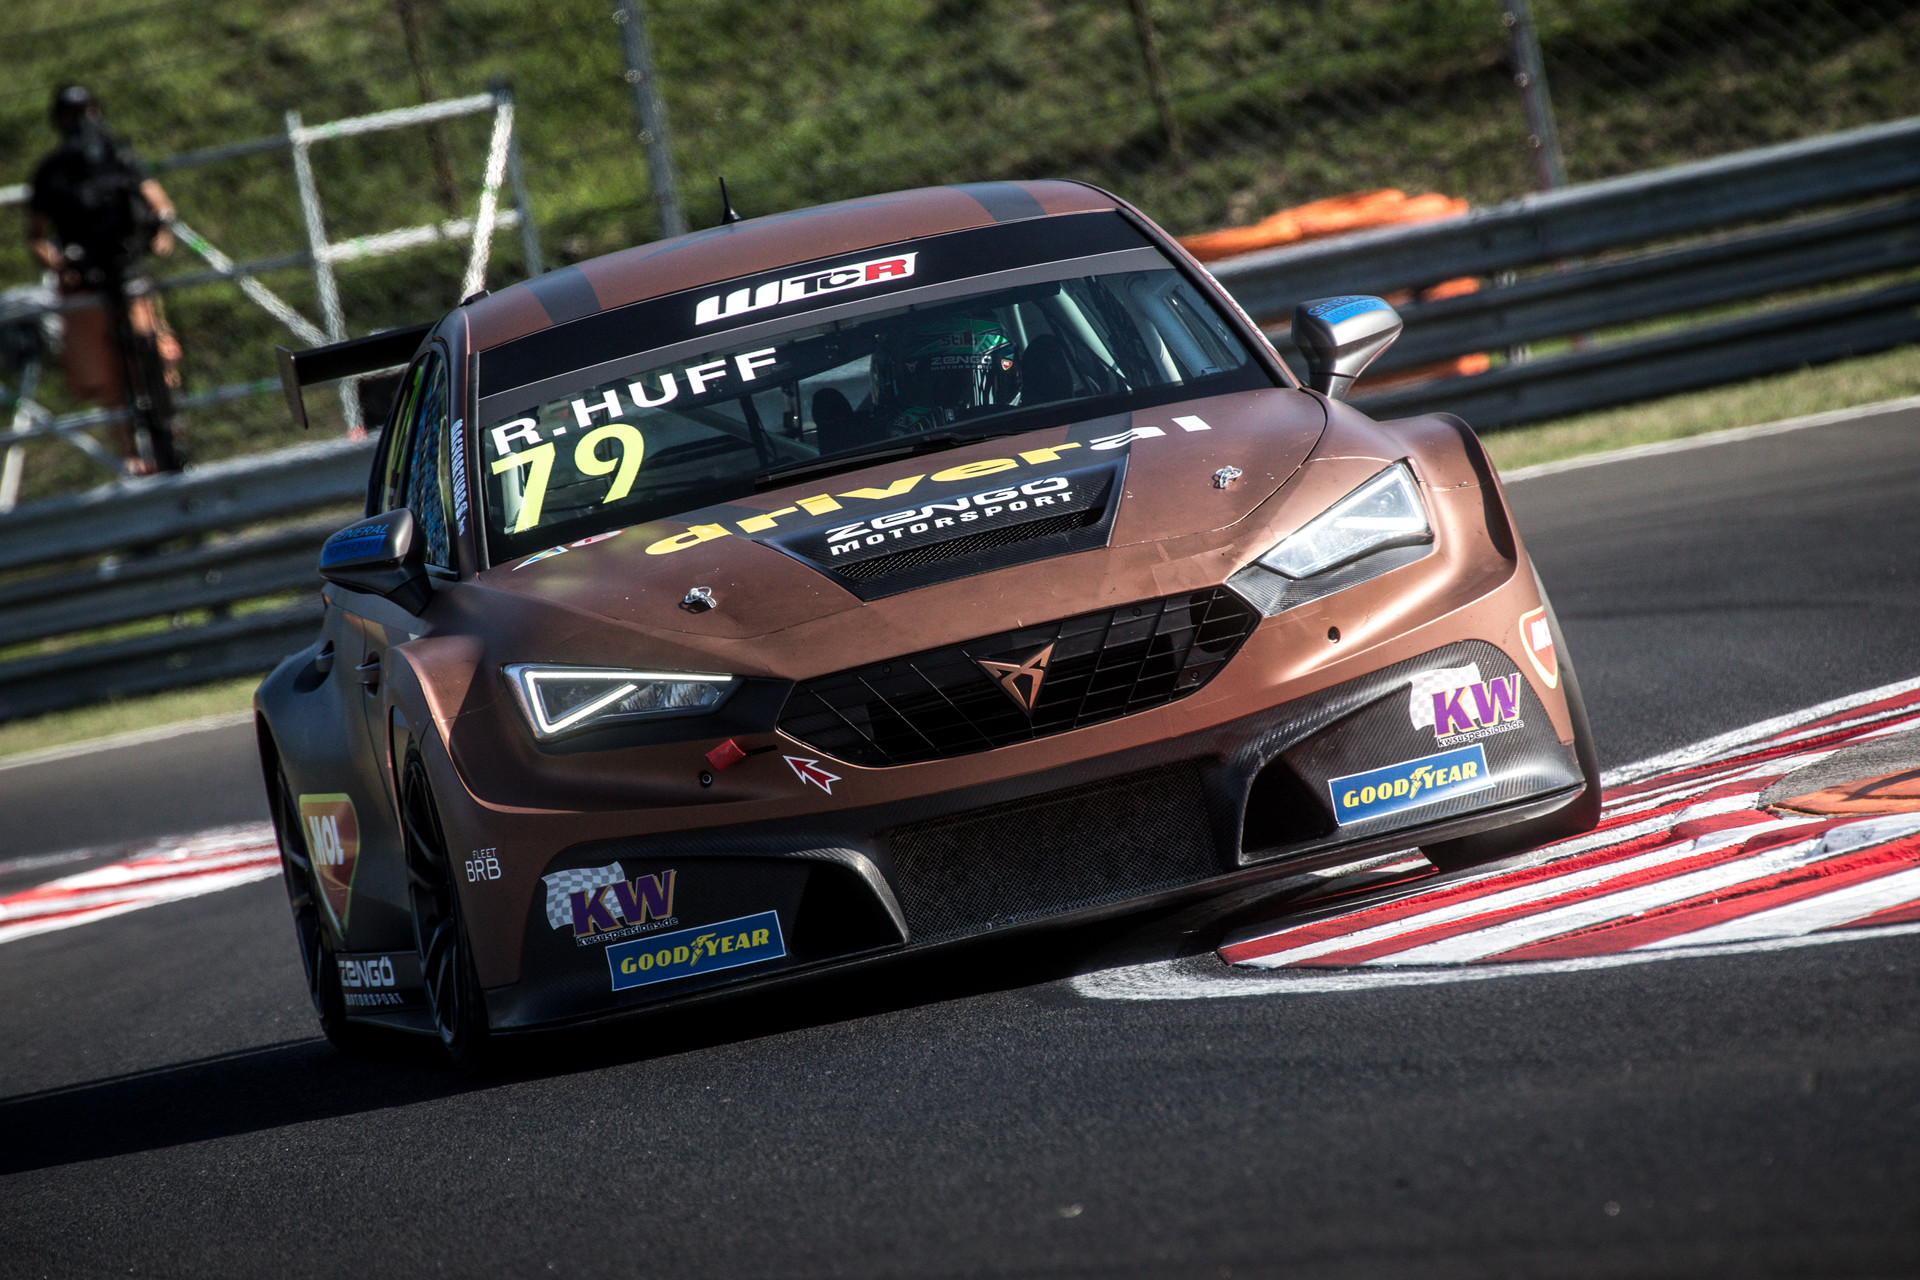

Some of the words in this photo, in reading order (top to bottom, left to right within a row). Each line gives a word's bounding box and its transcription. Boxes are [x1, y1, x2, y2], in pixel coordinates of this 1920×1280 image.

[695, 252, 919, 325] WTCR
[491, 347, 776, 455] R.HUFF
[491, 423, 644, 534] 79
[830, 491, 1073, 556] MOTORSPORT
[1431, 672, 1522, 738] KW
[1437, 719, 1525, 748] kwsuspensions.de
[308, 815, 345, 866] MOL
[465, 857, 502, 883] BRB
[472, 847, 497, 860] FLEET
[569, 868, 682, 938] KW
[576, 916, 679, 947] kwsuspensions.de
